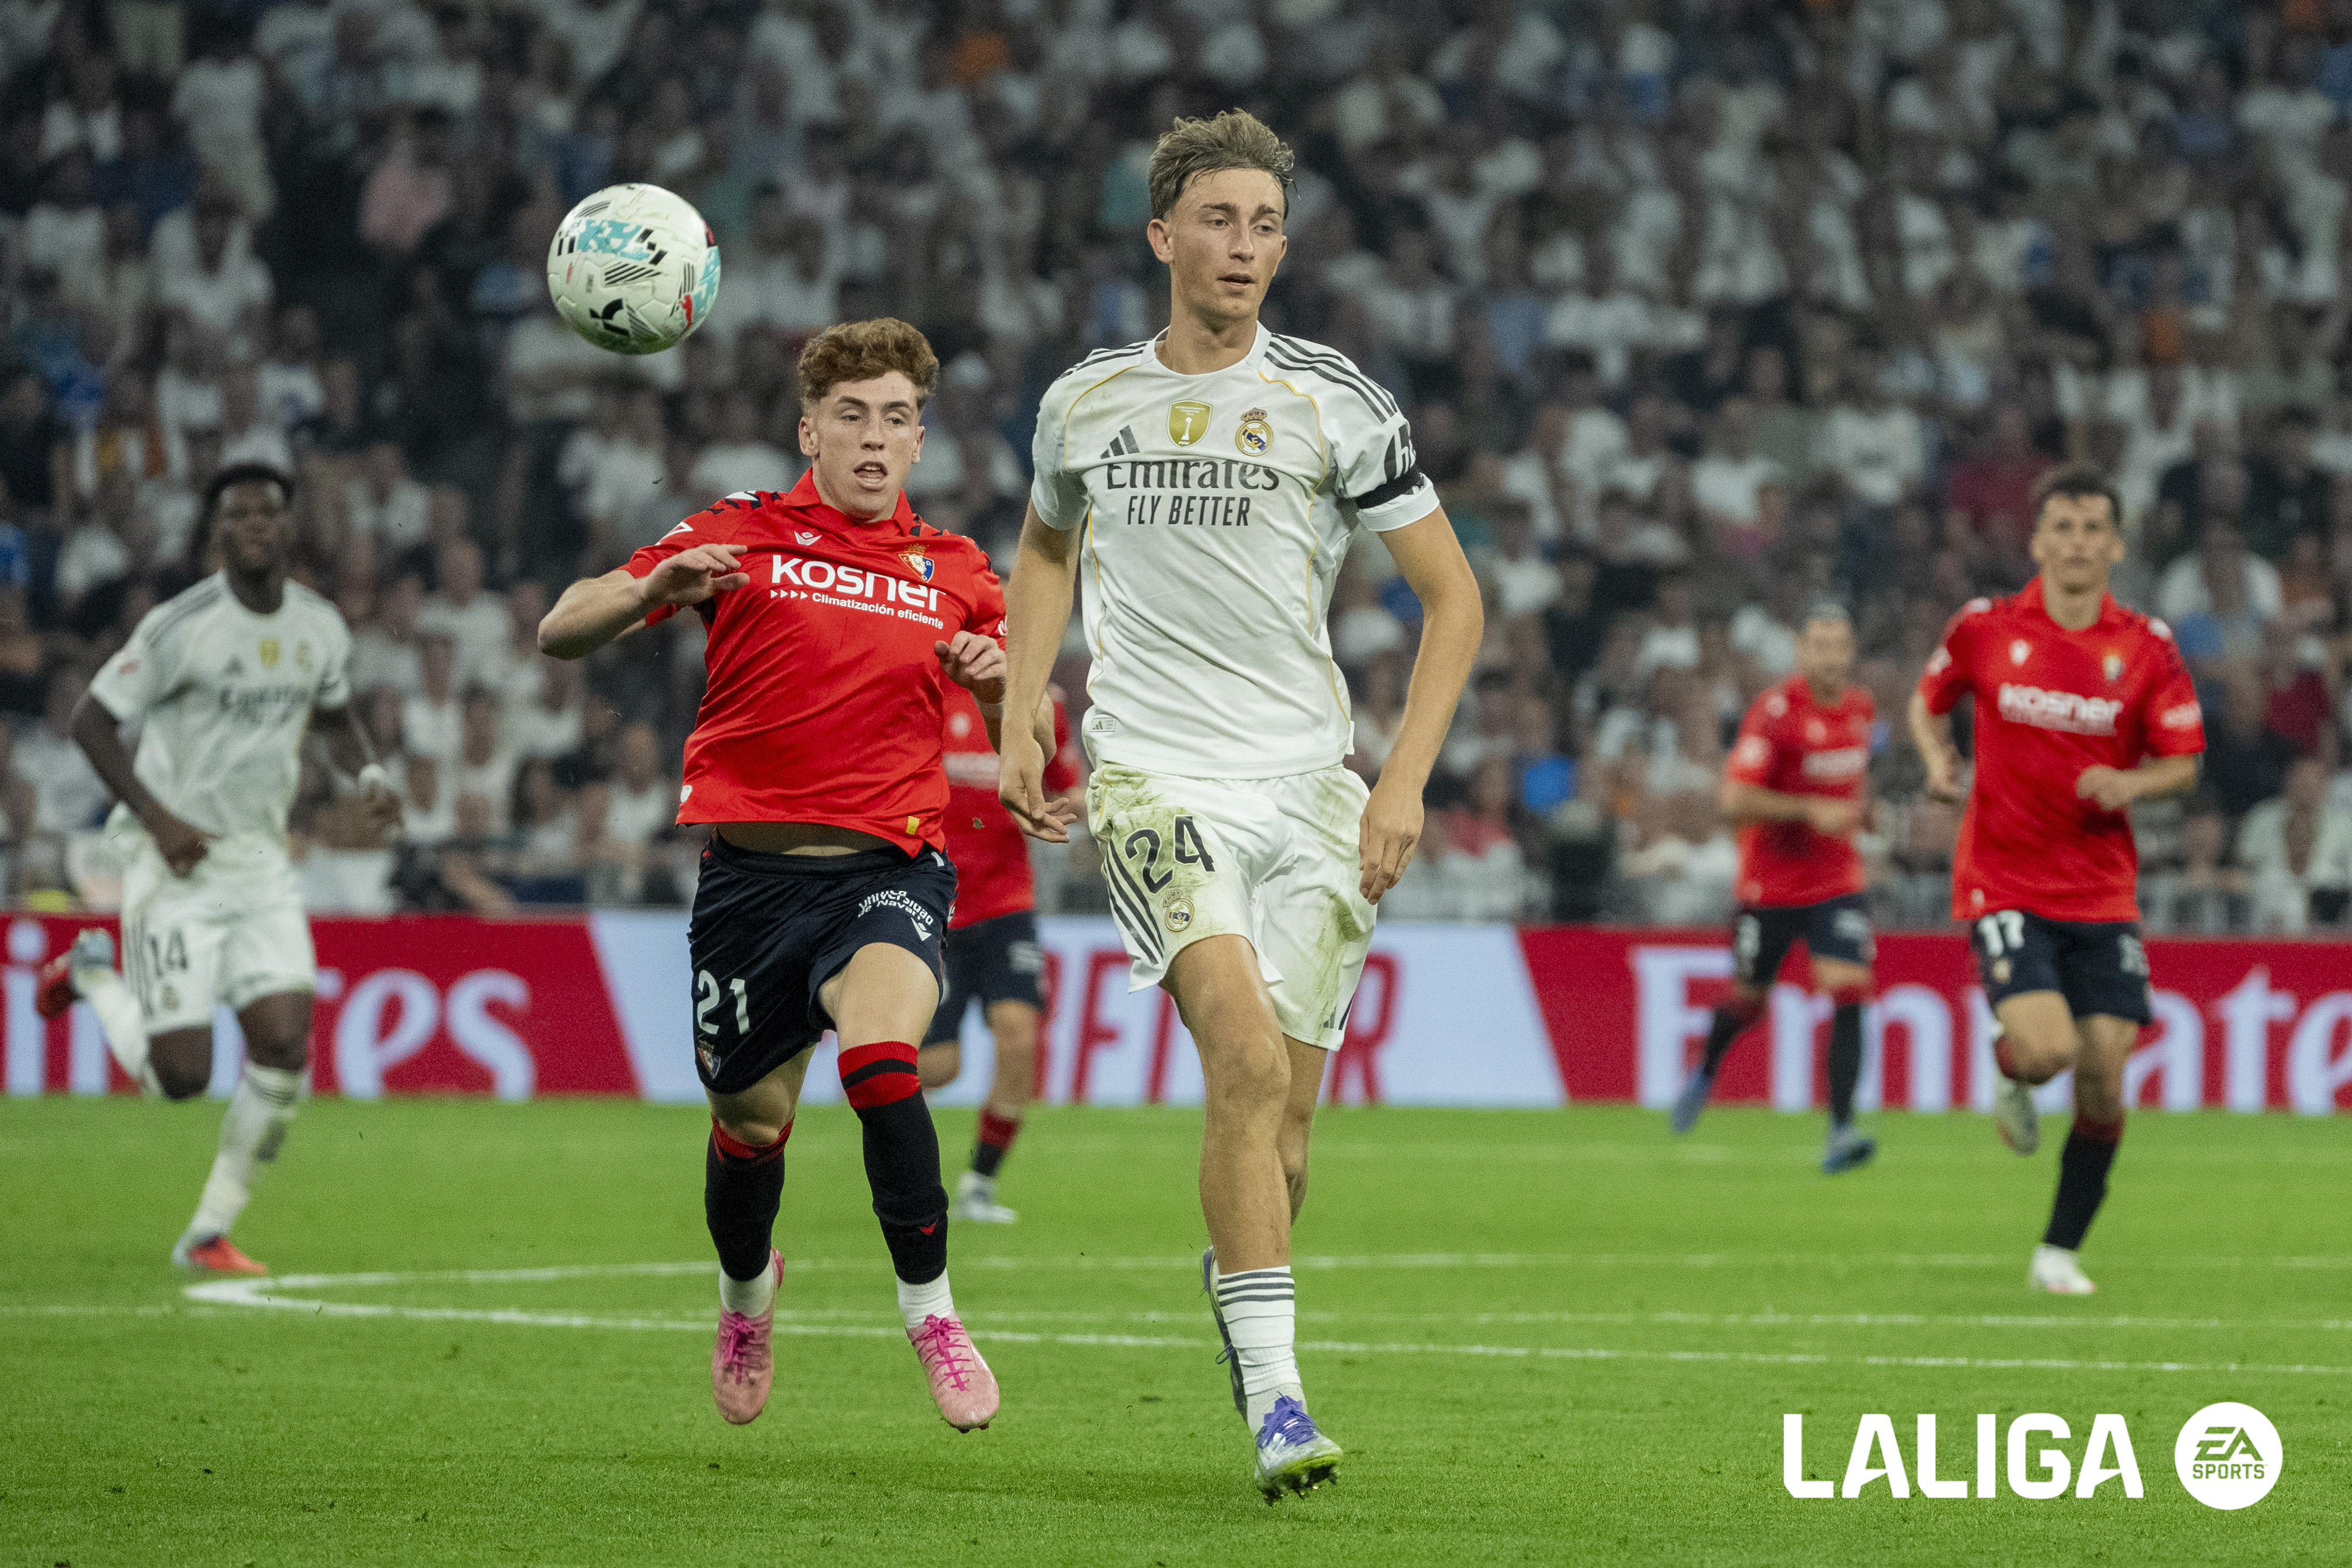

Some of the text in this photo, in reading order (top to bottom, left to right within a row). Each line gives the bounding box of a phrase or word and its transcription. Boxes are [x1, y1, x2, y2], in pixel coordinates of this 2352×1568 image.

[1107, 459, 1279, 491] Emirates
[1127, 495, 1251, 526] FLY BETTER
[812, 593, 943, 629] Climatización eficiente
[1125, 815, 1216, 895] 24
[146, 926, 191, 978] 14
[697, 970, 749, 1035] 21
